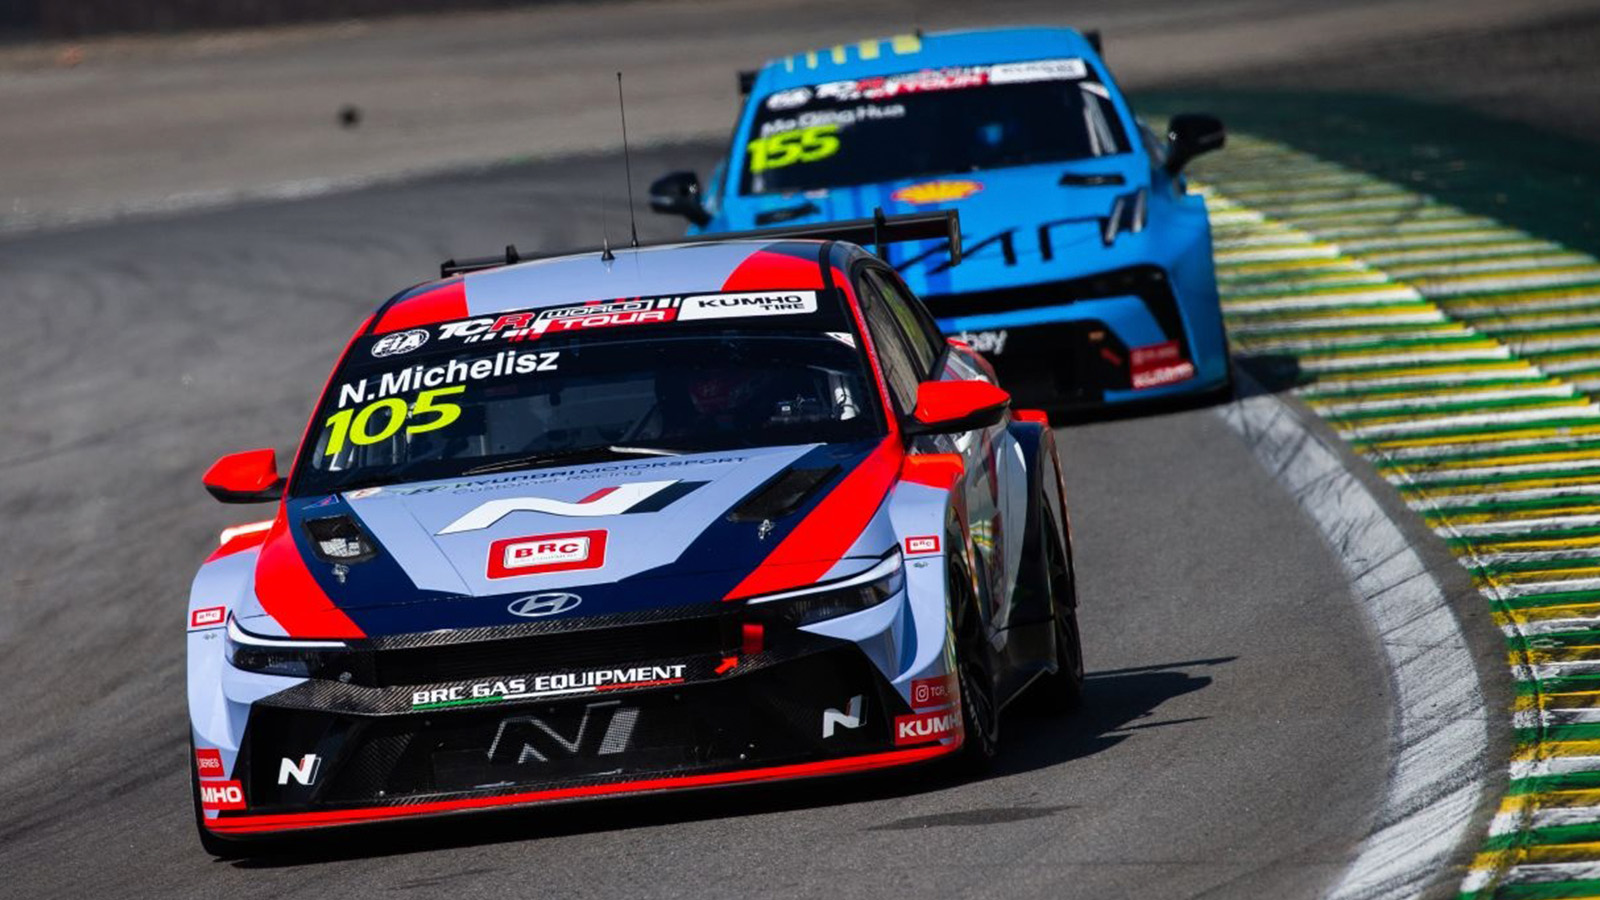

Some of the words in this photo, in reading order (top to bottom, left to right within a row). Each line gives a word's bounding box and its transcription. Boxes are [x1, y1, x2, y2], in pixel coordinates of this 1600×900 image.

[748, 123, 840, 173] 155
[549, 301, 642, 317] WORLD
[699, 295, 803, 308] KUMHO
[438, 312, 536, 340] TCR
[559, 311, 666, 329] TOUR
[375, 332, 424, 355] FIA
[338, 350, 560, 409] N.Michelisz
[325, 384, 467, 456] 105
[515, 543, 579, 558] BRC
[412, 687, 464, 705] BRC
[473, 679, 526, 696] GAS
[535, 664, 686, 692] EQUIPMENT
